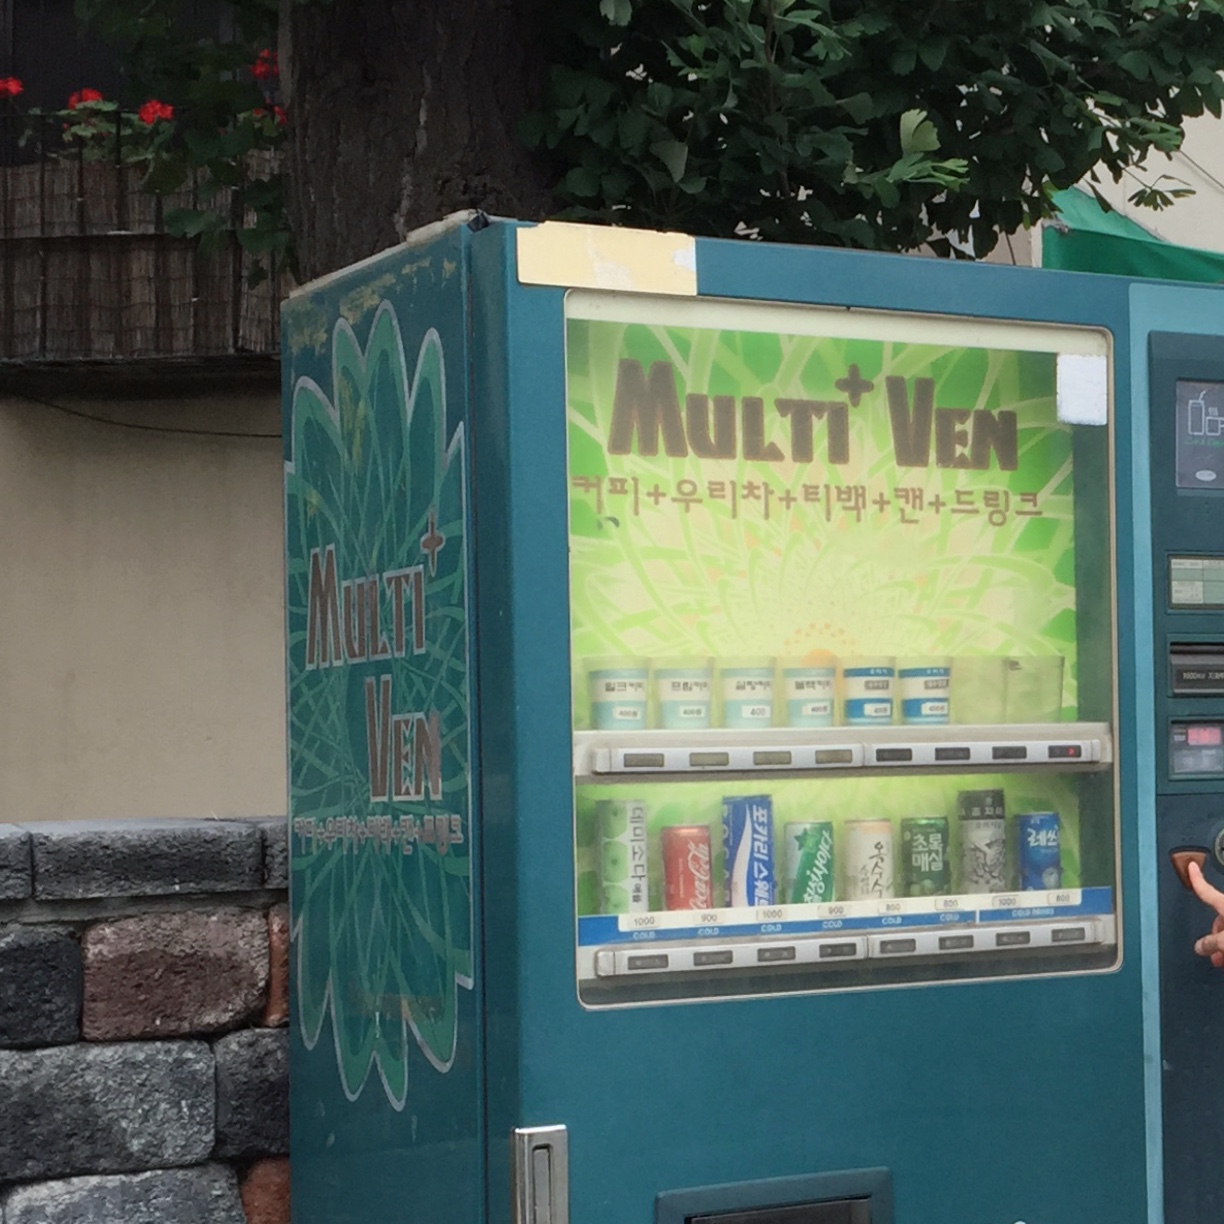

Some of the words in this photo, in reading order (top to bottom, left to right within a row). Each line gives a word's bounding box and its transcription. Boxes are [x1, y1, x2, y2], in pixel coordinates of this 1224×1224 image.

[885, 375, 1018, 471] VEN
[365, 674, 442, 801] VEN
[630, 806, 646, 881] 데미소다
[911, 833, 943, 852] 초록
[911, 851, 943, 872] 매실
[701, 913, 717, 922] 900
[762, 910, 782, 919] 1000
[939, 913, 960, 922] COLD
[634, 917, 655, 926] 1000
[822, 921, 843, 929] COLD
[881, 917, 903, 926] COLD
[698, 927, 720, 936] COLD
[761, 924, 782, 933] COLD
[633, 932, 655, 940] COLD
